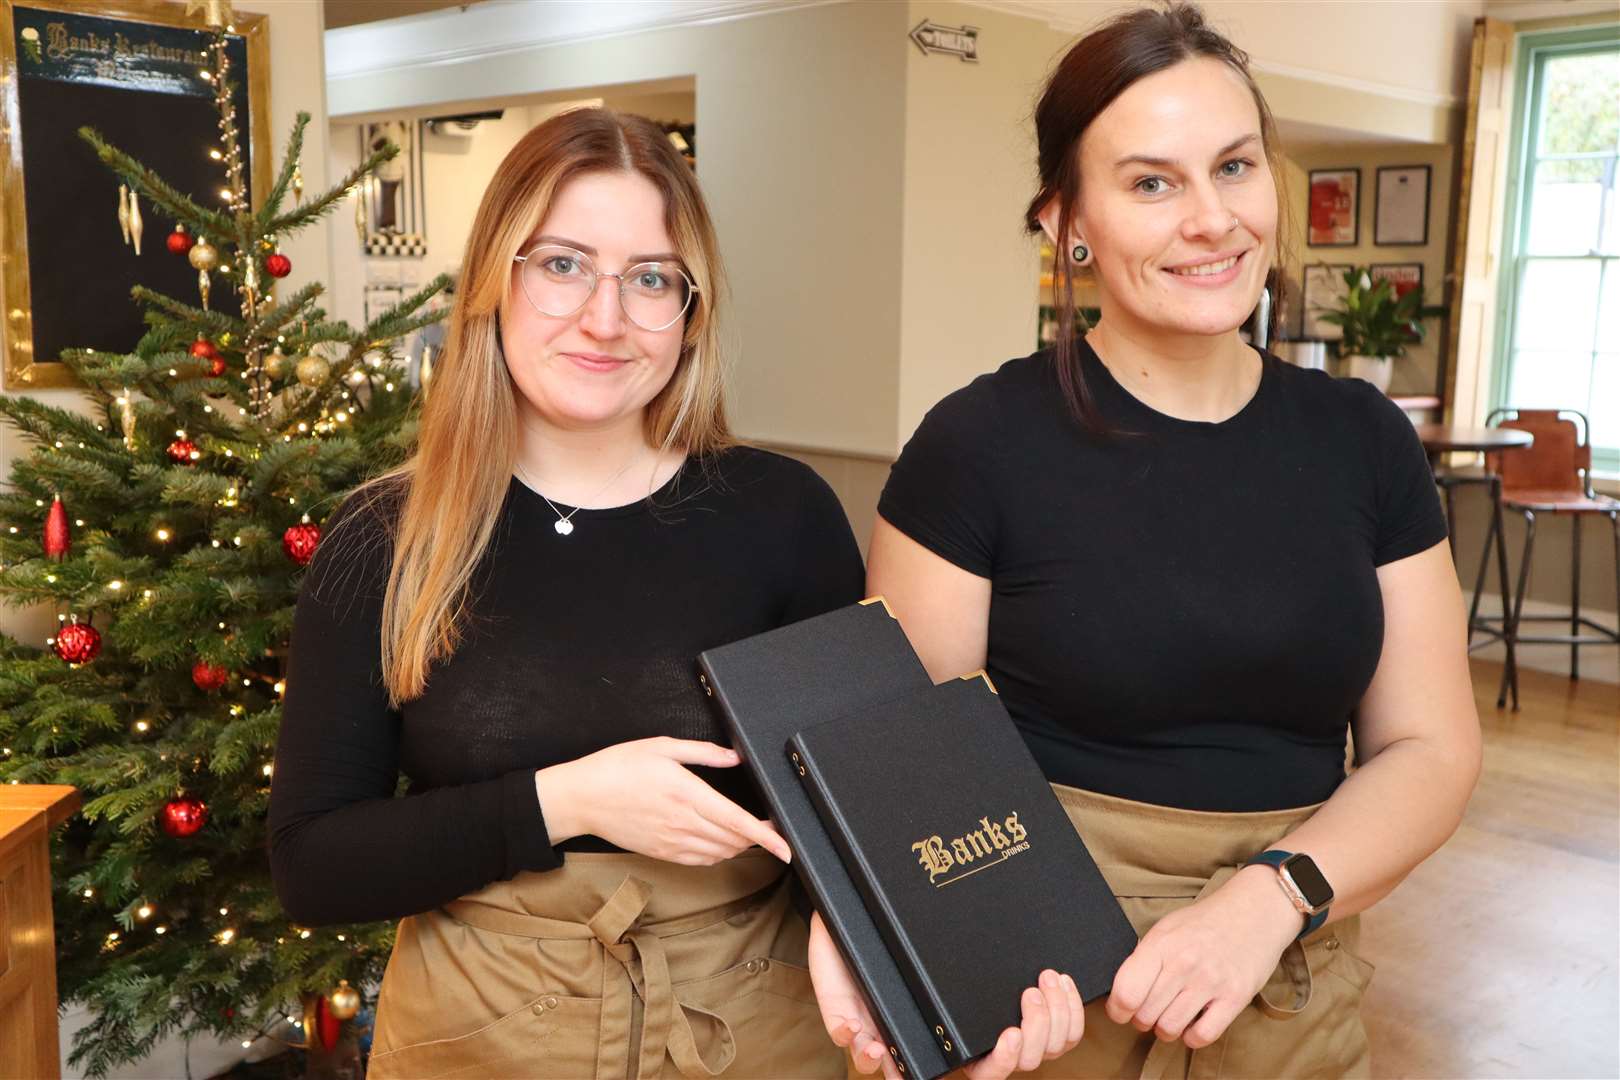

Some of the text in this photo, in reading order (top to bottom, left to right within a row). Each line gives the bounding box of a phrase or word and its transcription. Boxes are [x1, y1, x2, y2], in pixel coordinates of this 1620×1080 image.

[47, 22, 111, 58] Banks
[912, 811, 1027, 883] Banks
[1002, 841, 1030, 858] DRINKS
